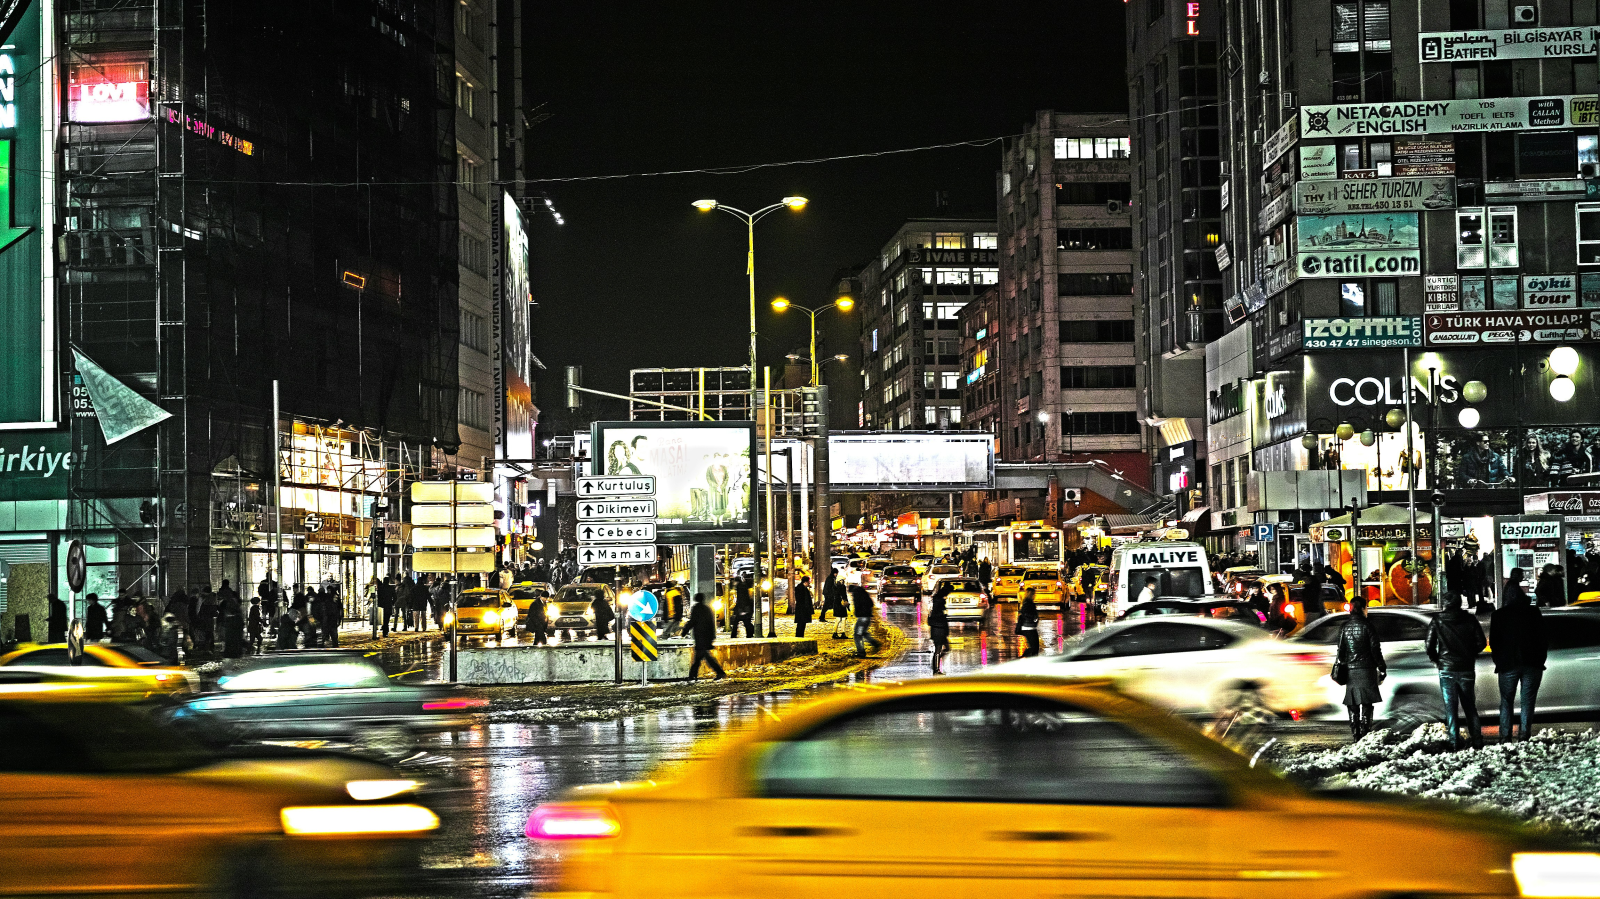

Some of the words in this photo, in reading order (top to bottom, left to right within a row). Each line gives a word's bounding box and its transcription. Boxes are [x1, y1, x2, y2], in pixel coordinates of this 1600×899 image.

[1504, 30, 1582, 43] BİLGİSAYAR
[1538, 100, 1554, 108] with
[1336, 103, 1450, 120] NETACADEMY
[1492, 111, 1515, 119] IELTS
[1357, 119, 1427, 134] ENGLISH
[1451, 122, 1488, 131] HAZIRLIK
[1490, 121, 1523, 129] ATLAMA
[1382, 180, 1423, 198] TURİZM
[1304, 194, 1325, 202] THY
[1404, 200, 1413, 208] 51
[1324, 254, 1418, 274] tatil.com
[1528, 277, 1571, 291] öykü
[1428, 292, 1456, 302] KIBRIS
[1528, 293, 1571, 305] tour
[1446, 314, 1482, 328] TÜRK
[1485, 316, 1524, 327] HAVA
[1305, 339, 1327, 348] 430
[1329, 339, 1344, 348] 47
[1345, 339, 1359, 347] 47
[597, 480, 651, 492] Kurtuluş
[597, 504, 651, 514] Dikimevi
[598, 527, 648, 537] Cebeci
[1258, 525, 1270, 541] P
[1501, 524, 1558, 537] taşpınar
[598, 548, 651, 559] Mamak
